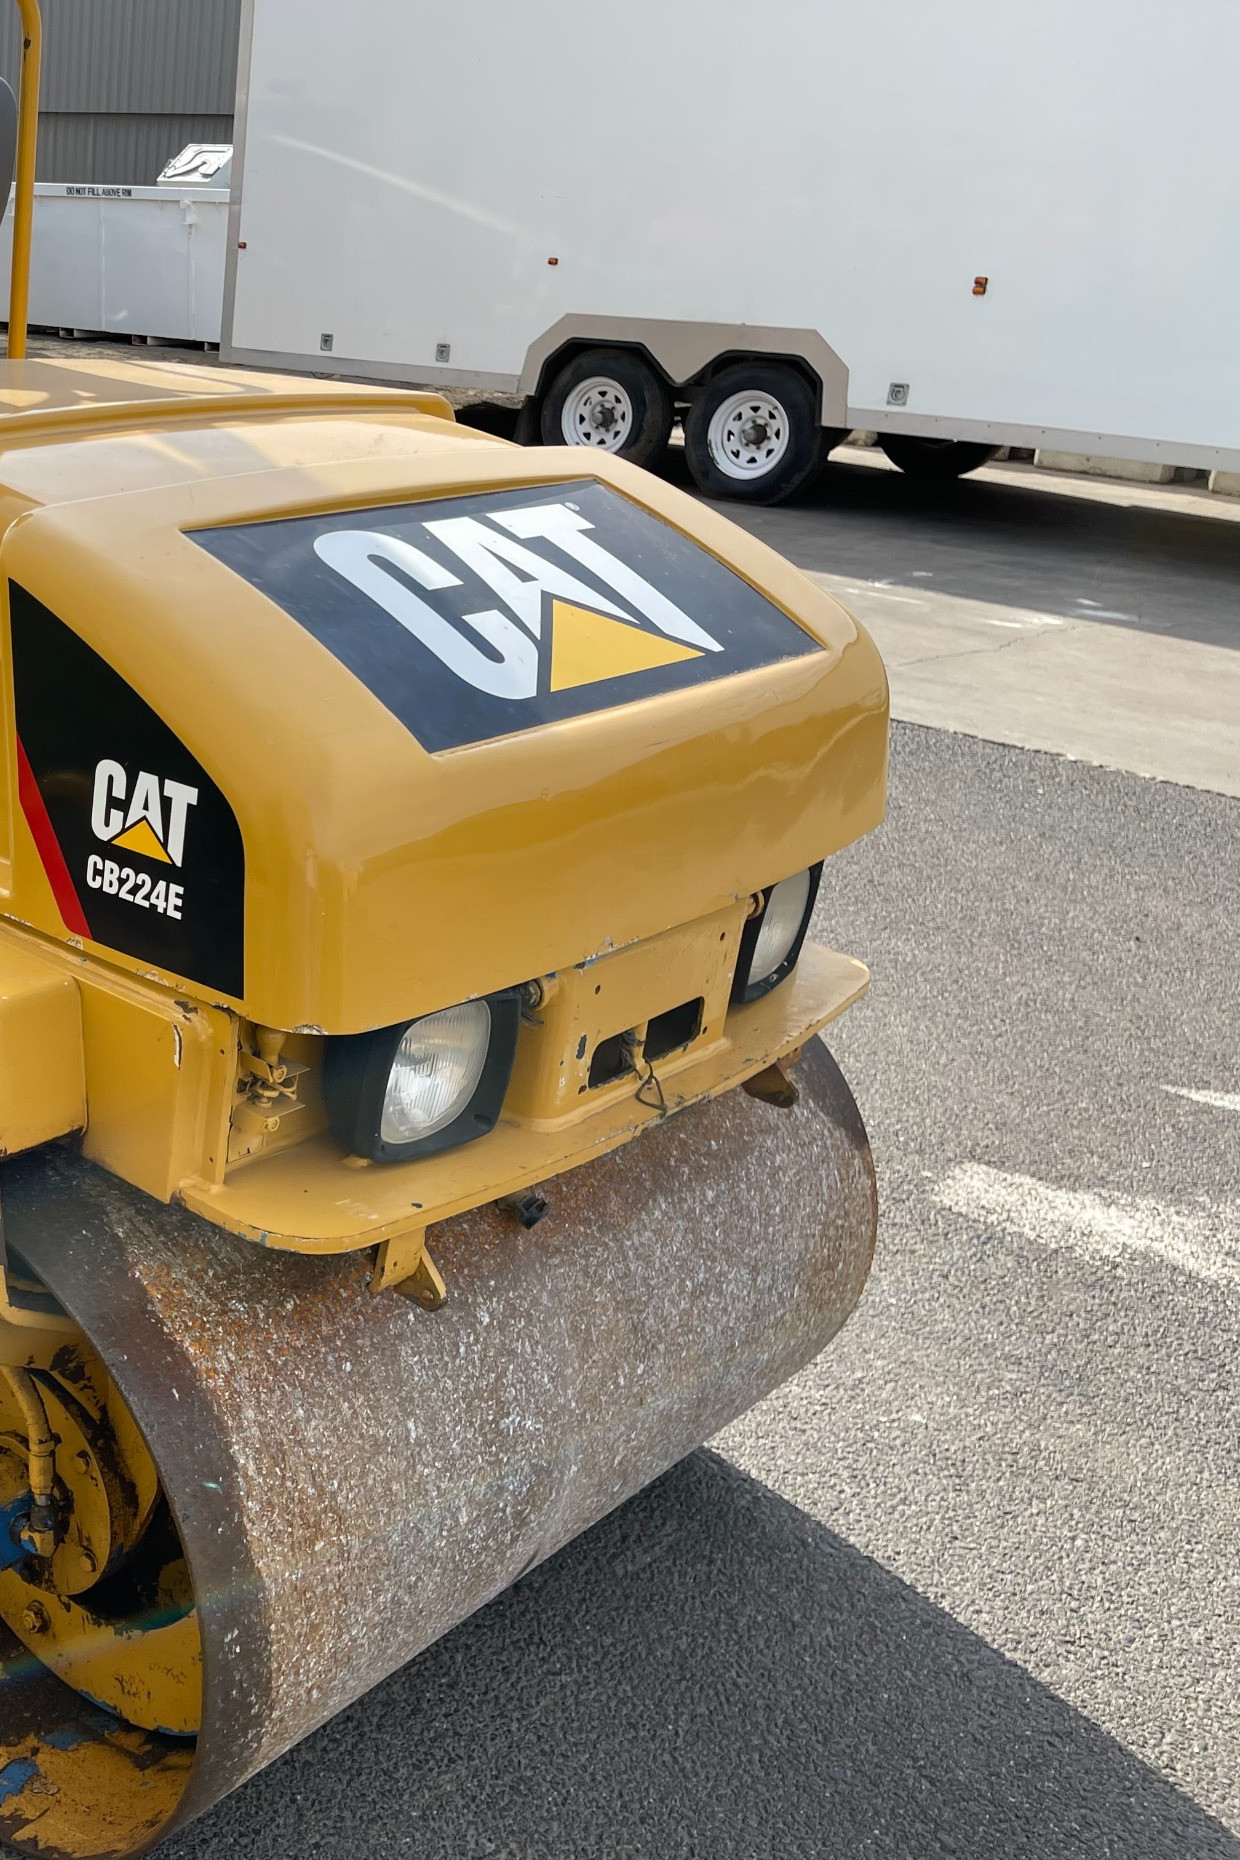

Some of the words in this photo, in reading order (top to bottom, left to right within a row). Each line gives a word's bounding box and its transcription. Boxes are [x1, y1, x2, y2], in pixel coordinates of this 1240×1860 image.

[66, 187, 74, 195] DO
[76, 187, 86, 195] NOT
[87, 188, 100, 197] FILL
[101, 189, 121, 197] ABOVE
[122, 189, 132, 197] RIM
[313, 503, 725, 700] CAT
[91, 758, 199, 868] CAT
[86, 853, 185, 921] CB224E
